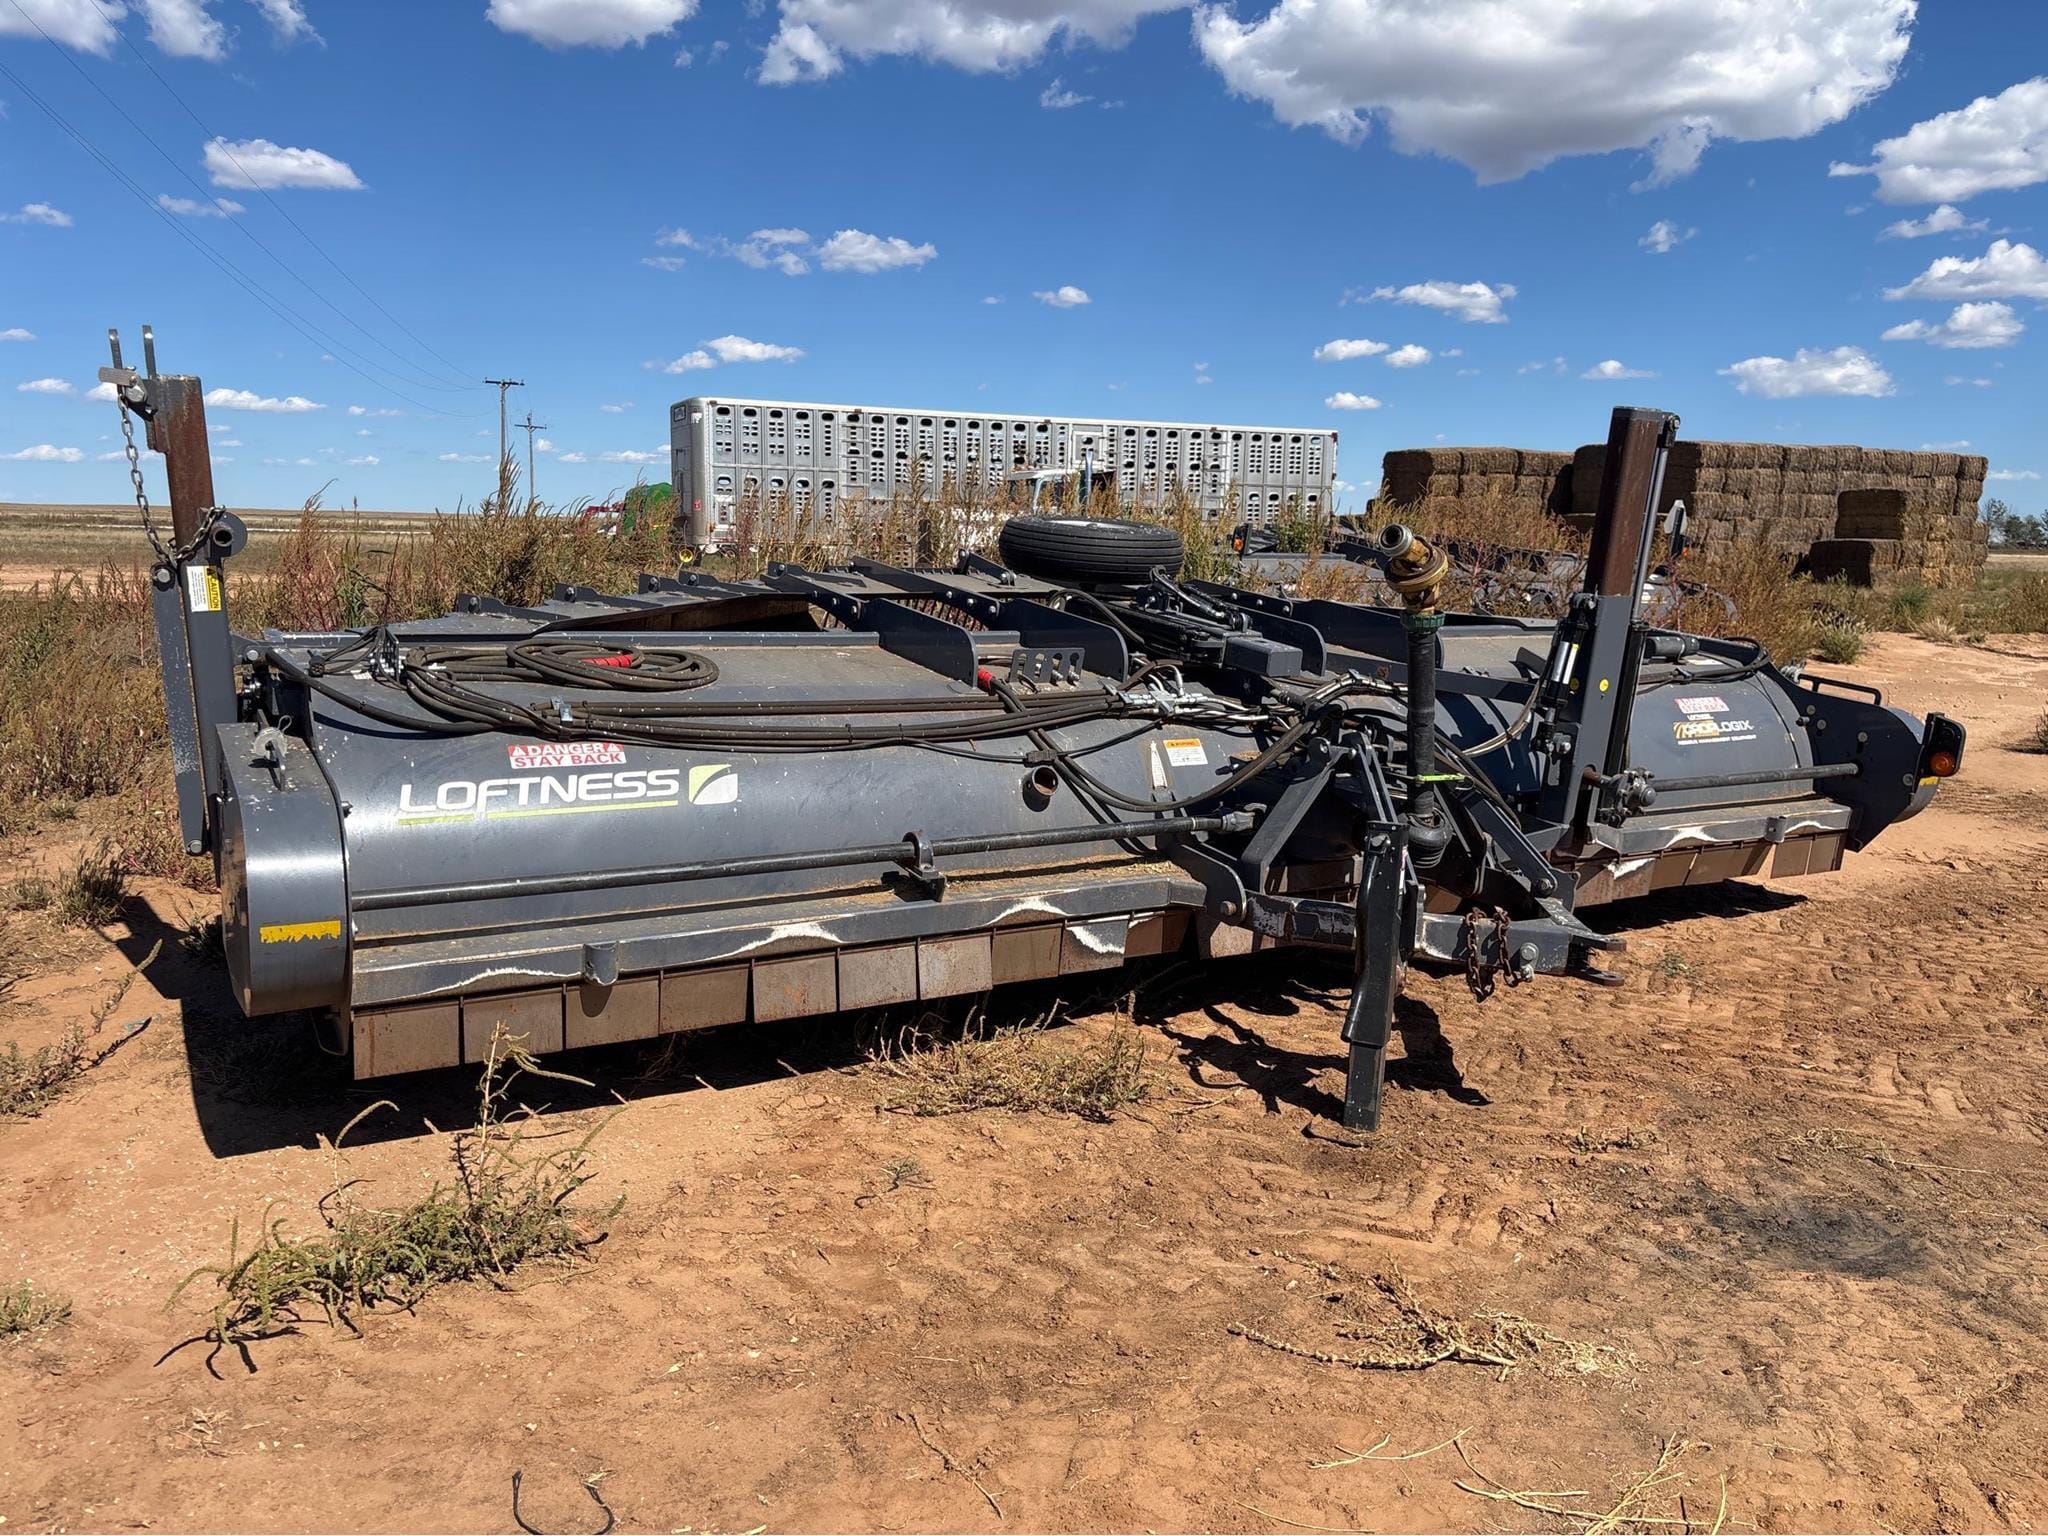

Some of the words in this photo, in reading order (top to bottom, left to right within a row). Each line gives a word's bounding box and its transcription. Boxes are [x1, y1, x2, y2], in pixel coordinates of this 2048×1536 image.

[210, 575, 220, 608] CAUTION
[515, 756, 564, 767] STAY
[571, 753, 622, 765] BACK
[527, 743, 605, 756] DANGER
[399, 768, 680, 819] LOFTNESS
